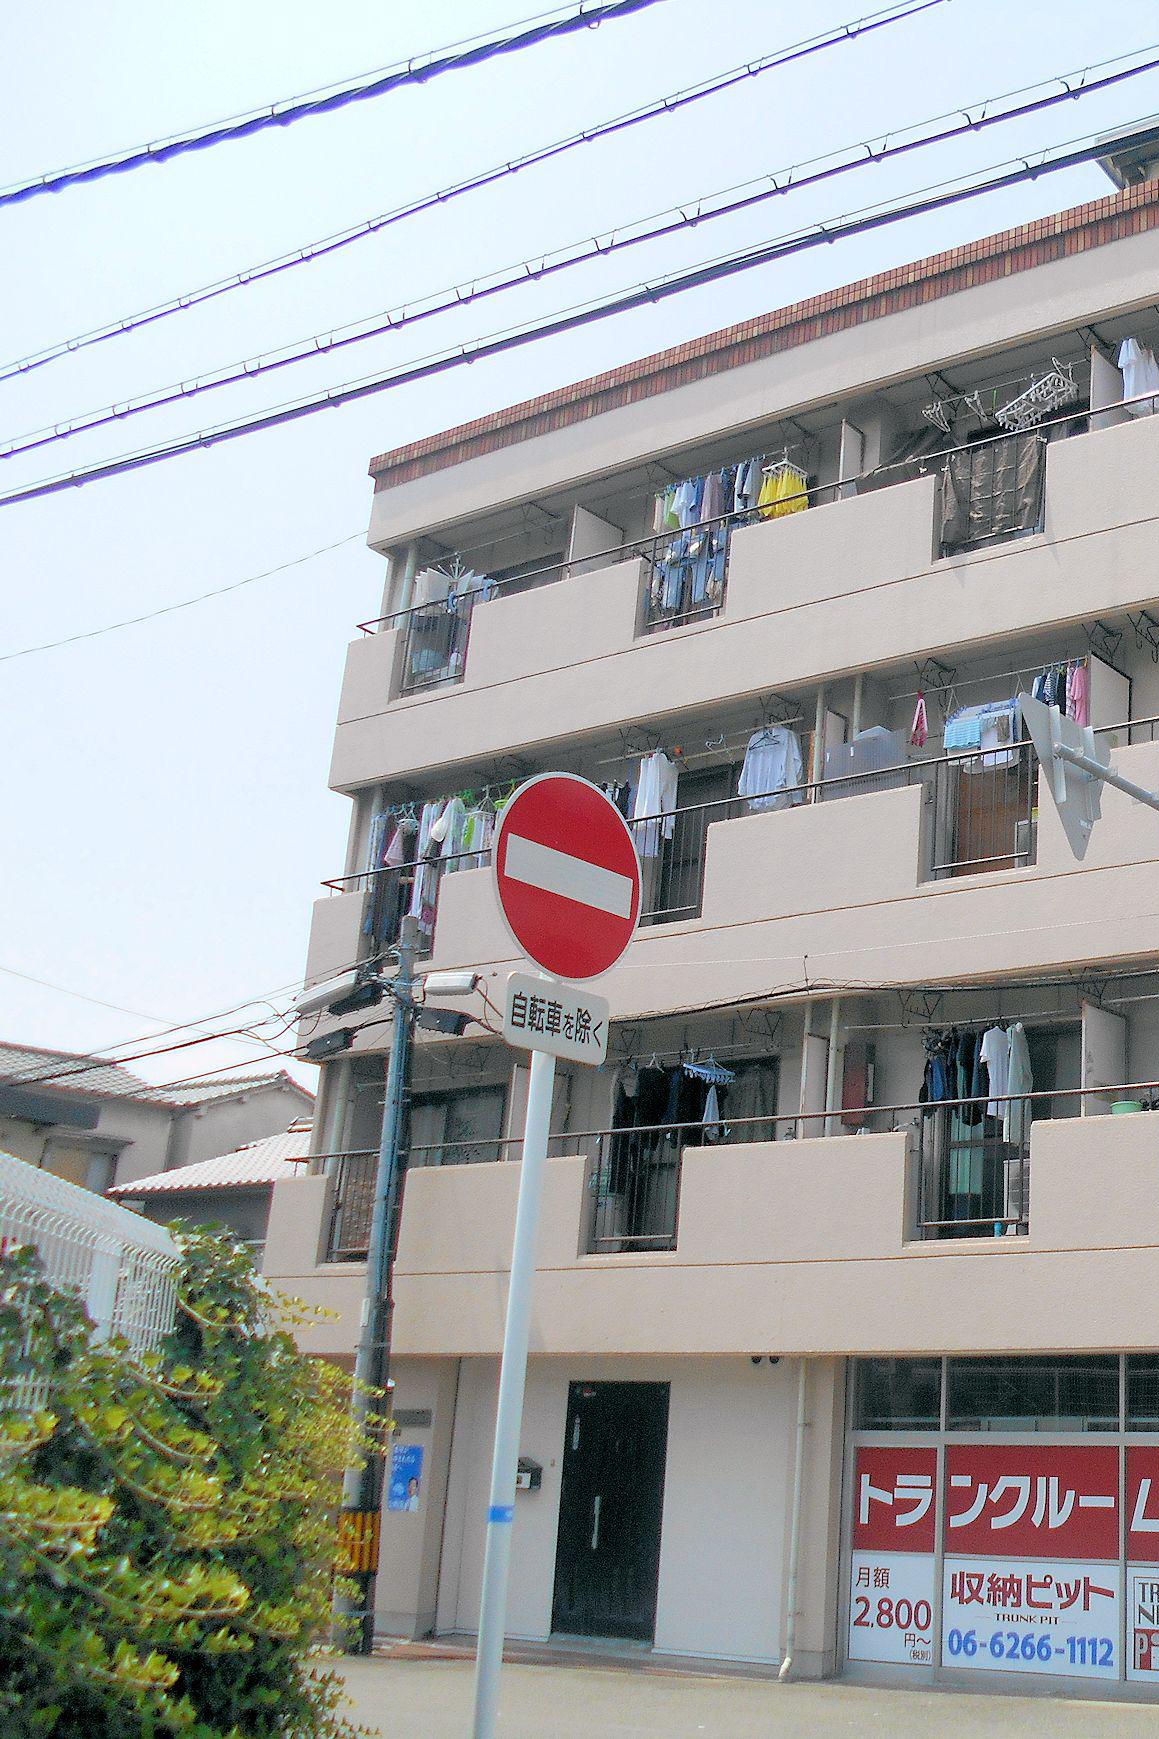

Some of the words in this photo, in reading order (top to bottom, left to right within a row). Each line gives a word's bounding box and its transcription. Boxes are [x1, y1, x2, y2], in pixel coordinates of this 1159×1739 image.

[511, 991, 603, 1048] 自転車を除く
[855, 1566, 890, 1589] 月額
[950, 1571, 1115, 1611] 収納ピット
[853, 1596, 931, 1631] 2,800
[995, 1613, 1037, 1623] TRUNK
[1040, 1616, 1060, 1625] PIT
[948, 1628, 1114, 1667] 06-6266-1112
